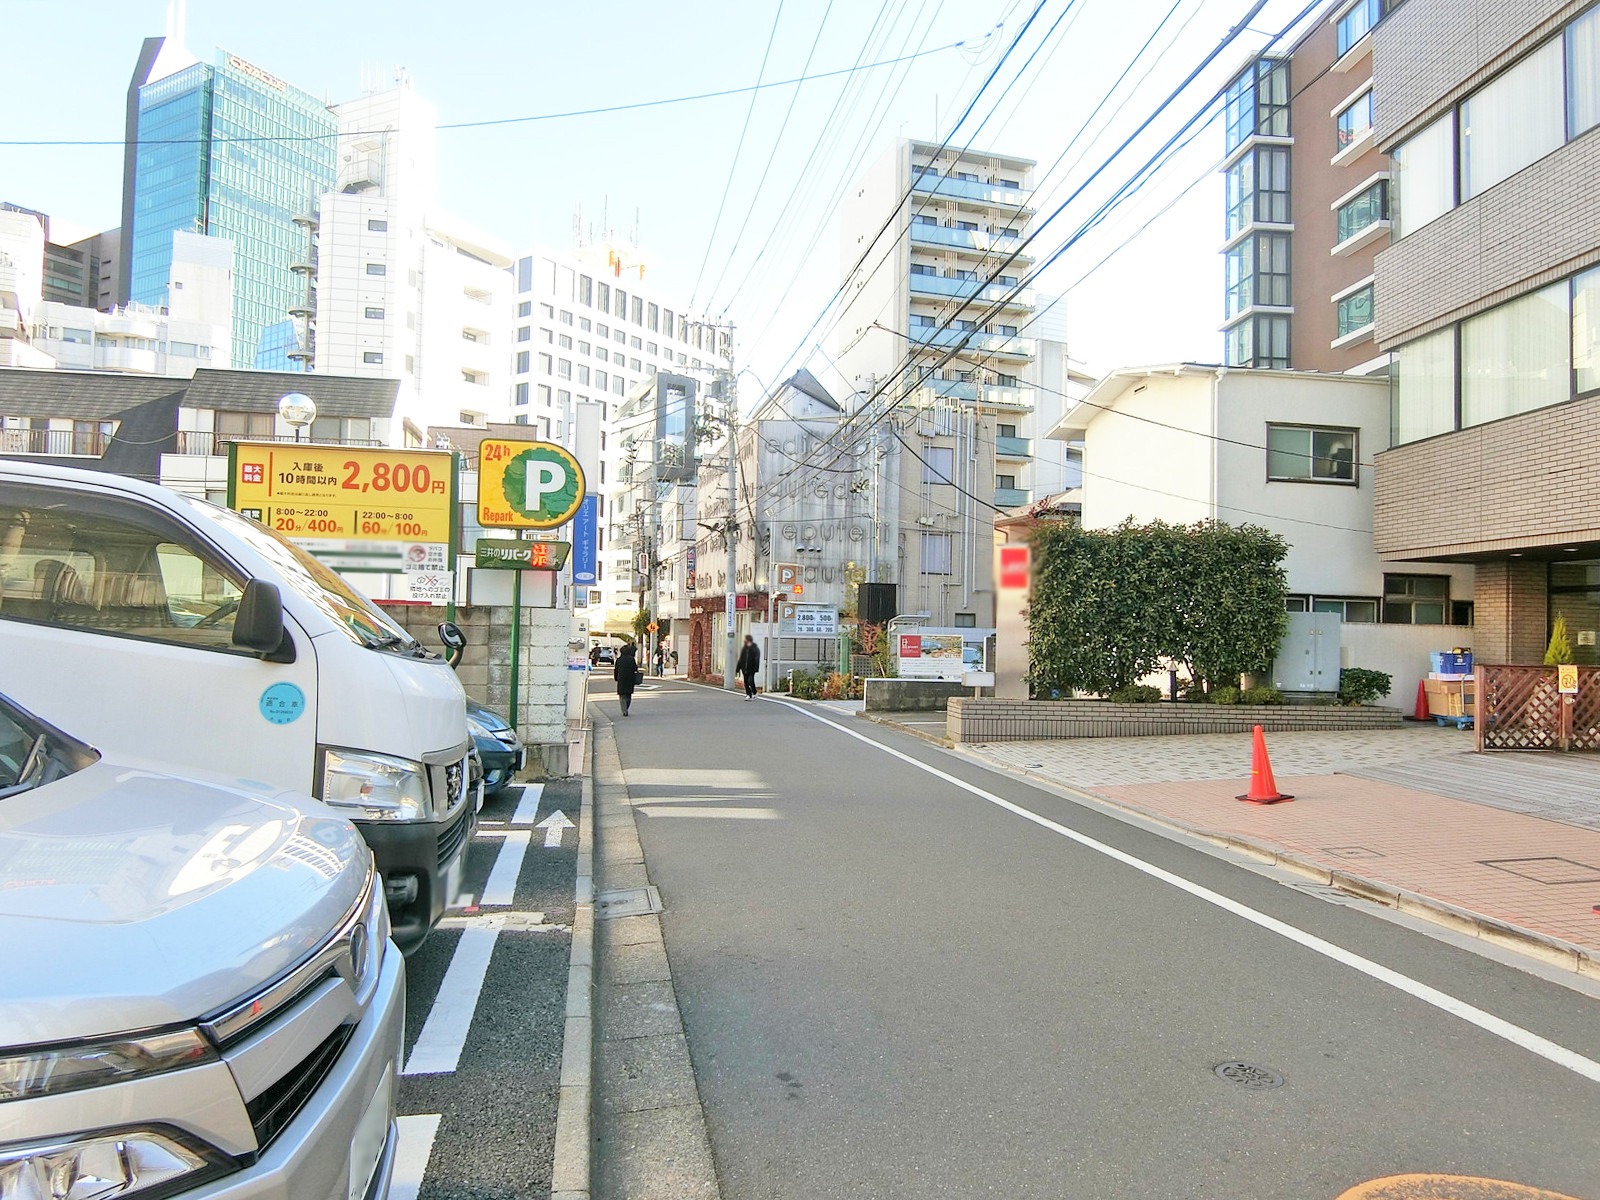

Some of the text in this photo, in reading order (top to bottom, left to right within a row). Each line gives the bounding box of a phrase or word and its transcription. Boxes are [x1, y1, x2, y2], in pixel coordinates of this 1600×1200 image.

[484, 443, 511, 462] 24h
[243, 464, 262, 474] 最大
[292, 461, 324, 473] 入庫後
[243, 473, 262, 483] 料金
[278, 472, 338, 487] 10時間以内
[341, 460, 446, 495] 2,800円
[525, 460, 567, 512] P
[483, 506, 514, 522] Repark
[480, 547, 532, 561] 三井のリパーク
